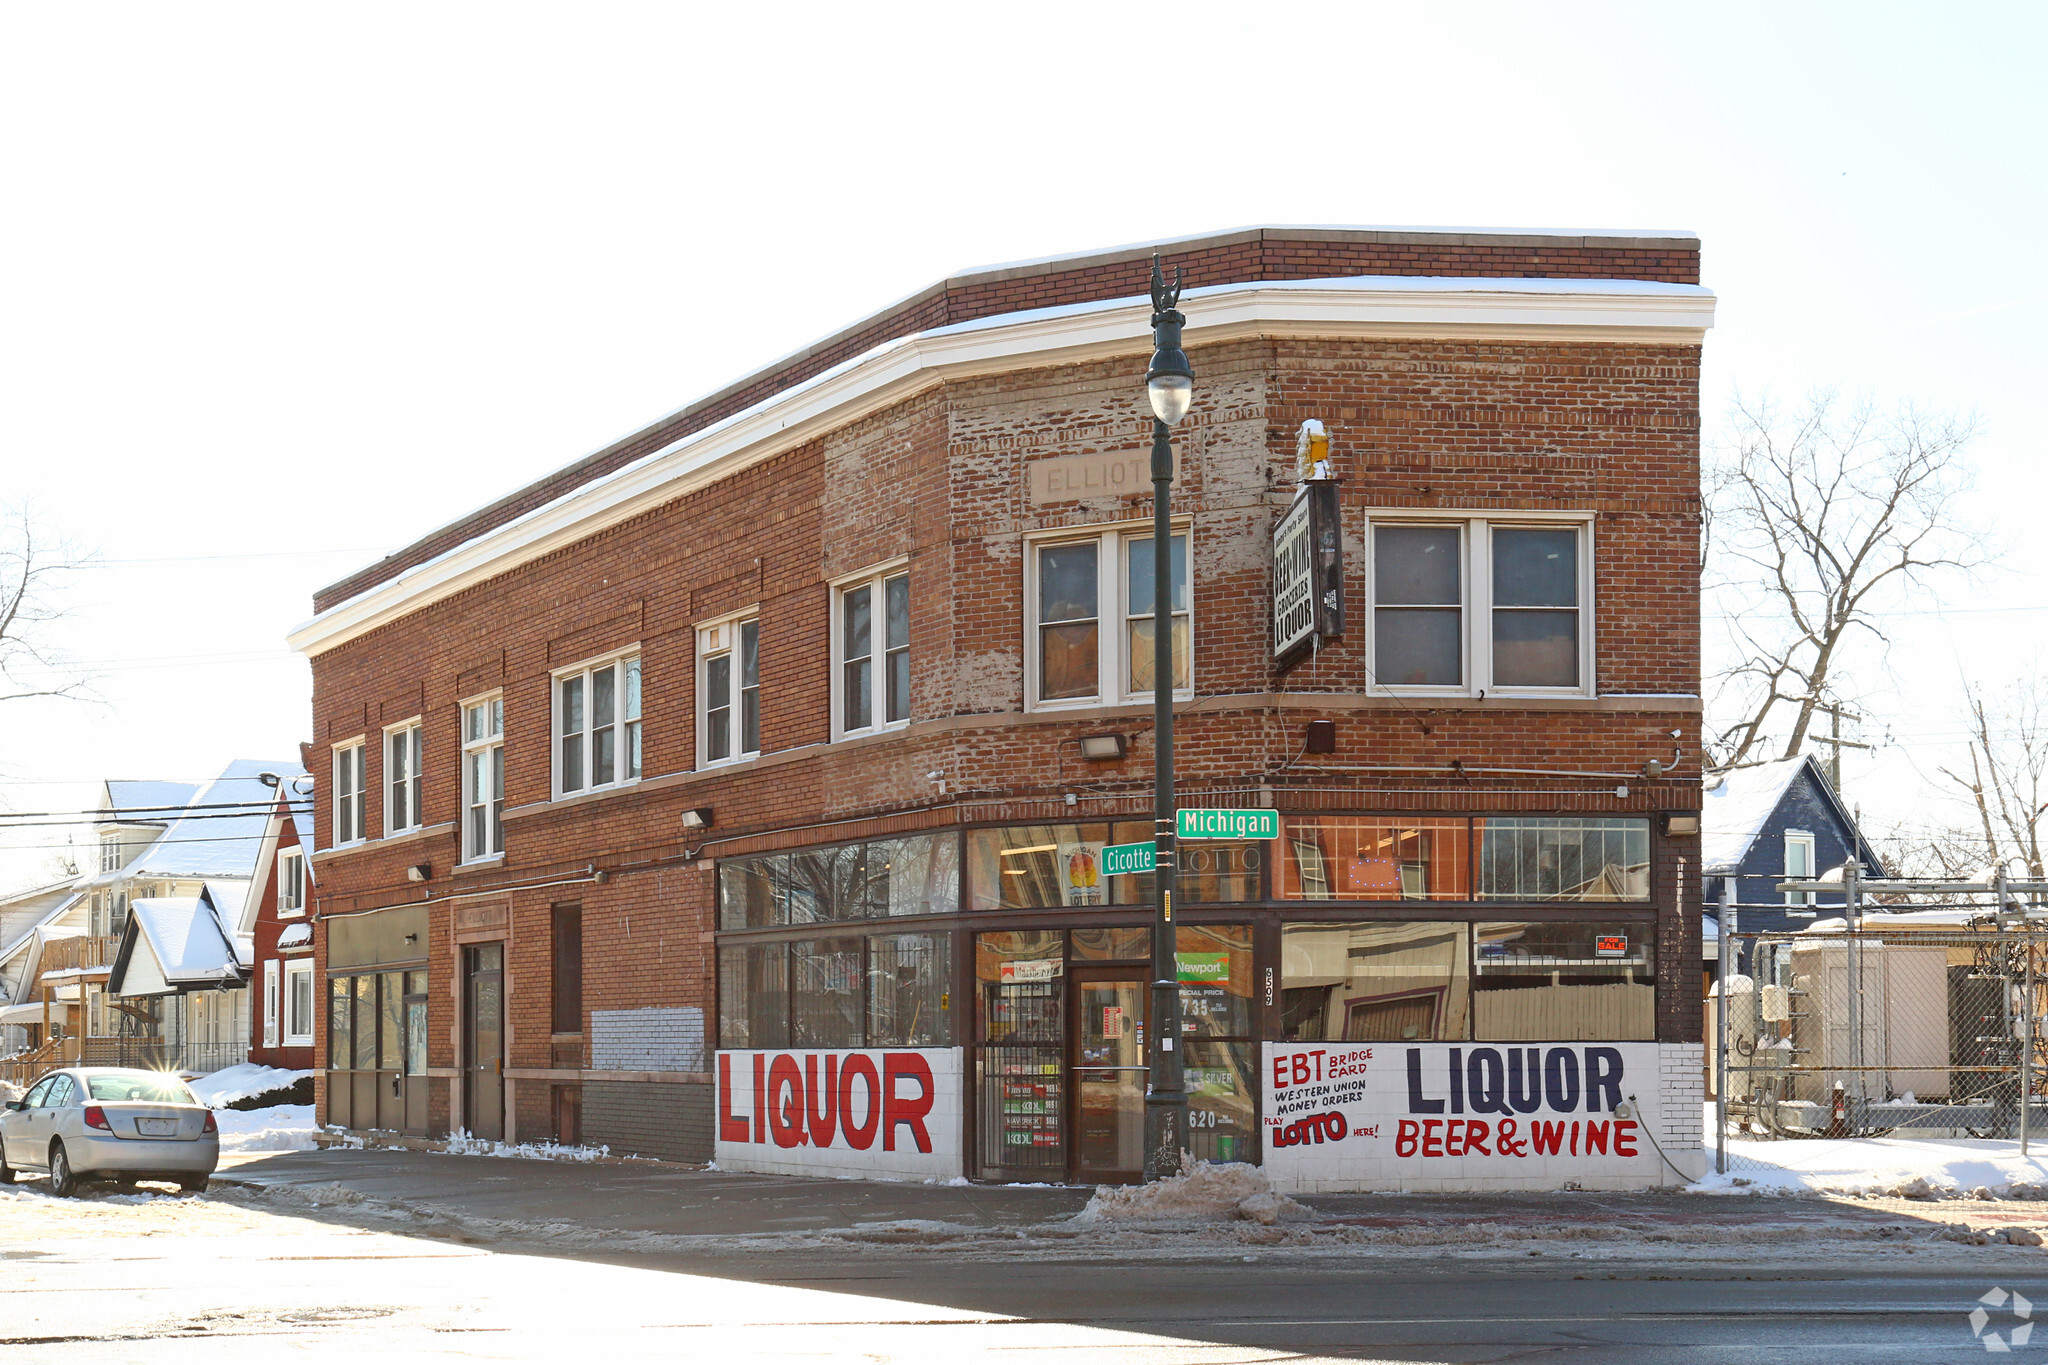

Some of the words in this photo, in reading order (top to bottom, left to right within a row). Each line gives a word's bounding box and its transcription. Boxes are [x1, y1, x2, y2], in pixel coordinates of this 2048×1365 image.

[1048, 459, 1150, 493] ELLIOT
[1277, 577, 1308, 617] GROCERIES
[1276, 598, 1312, 648] LIQUOR
[1185, 811, 1270, 838] Michigan
[1065, 846, 1098, 861] MICHIGAN
[1107, 850, 1151, 872] Cicotte
[1177, 847, 1261, 872] LOTTO
[1598, 942, 1626, 950] SALE
[1176, 961, 1222, 975] Newport
[1265, 967, 1273, 1005] 6509
[1273, 1049, 1327, 1089] EBT
[1329, 1048, 1374, 1067] BRIDGE
[1205, 1072, 1232, 1084] SILVER
[1328, 1063, 1367, 1079] CARD
[1406, 1046, 1624, 1117] LIQUOR
[718, 1052, 935, 1154] LIQUOR
[1275, 1085, 1330, 1103] WESTERN
[1333, 1079, 1366, 1093] UNION
[1021, 1101, 1041, 1110] KOOL
[1277, 1100, 1318, 1116] MONEY
[1322, 1091, 1363, 1106] ORDERS
[1264, 1117, 1284, 1126] PLAY
[1272, 1110, 1348, 1148] LOTTO
[1353, 1124, 1379, 1139] HERE!
[1007, 1133, 1032, 1145] KOOL
